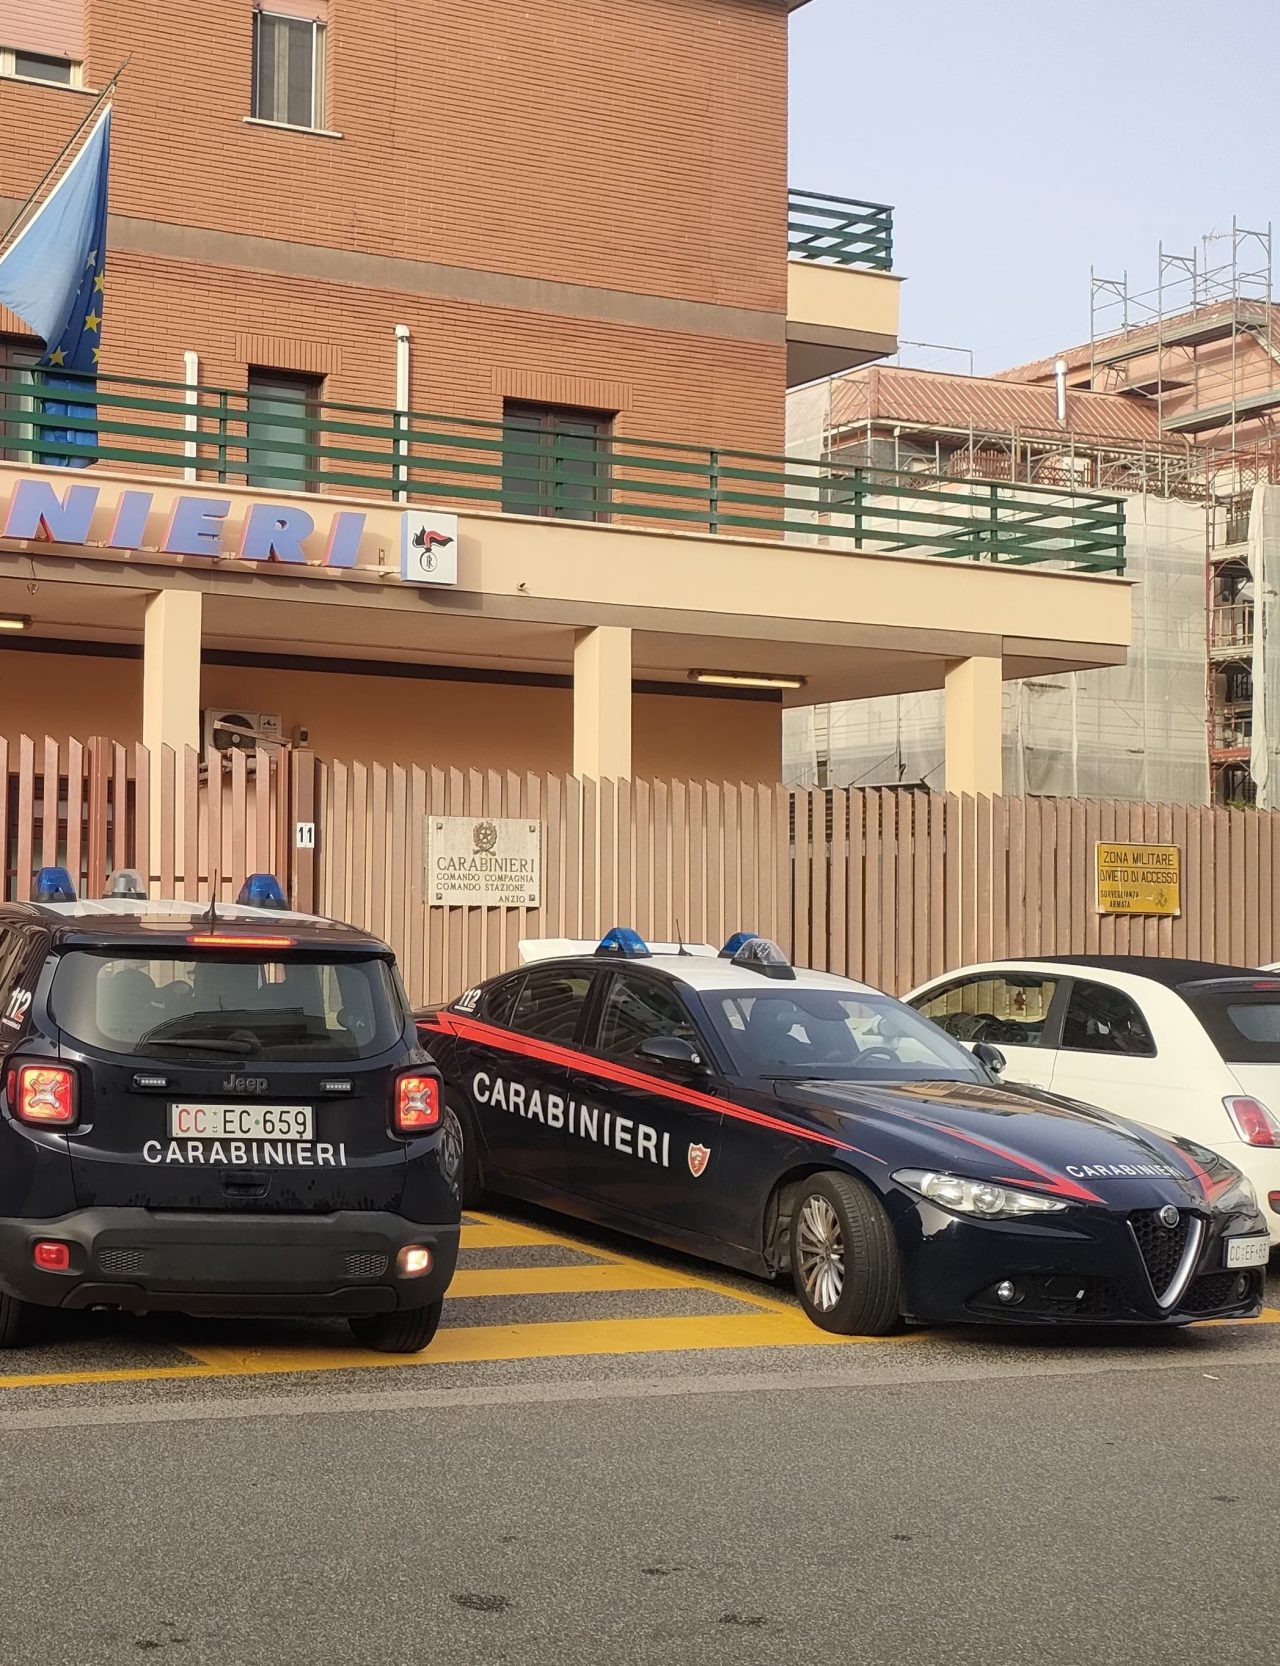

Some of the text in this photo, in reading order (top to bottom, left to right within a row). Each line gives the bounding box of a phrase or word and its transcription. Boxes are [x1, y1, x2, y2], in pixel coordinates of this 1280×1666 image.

[298, 826, 312, 843] 11
[437, 856, 535, 873] CARABINIERI
[1103, 851, 1174, 866] ZONA MILITARE
[436, 872, 534, 883] COMANDO COMPAGNIA
[1100, 869, 1177, 884] DIVIETO DI ACCESSO
[436, 882, 526, 892] COMANDO STAZIONE
[1100, 890, 1139, 898] SORVEGLIANZA
[498, 895, 526, 903] ANZIO
[1109, 900, 1131, 908] ARMATA
[6, 987, 32, 1022] 112
[459, 988, 481, 1009] 112
[223, 1073, 269, 1096] Jeep
[178, 1108, 307, 1135] CC EC 659
[473, 1071, 670, 1168] CARABINIERI
[142, 1140, 347, 1166] CARABINIERI
[1065, 1164, 1186, 1178] CARABINIERI
